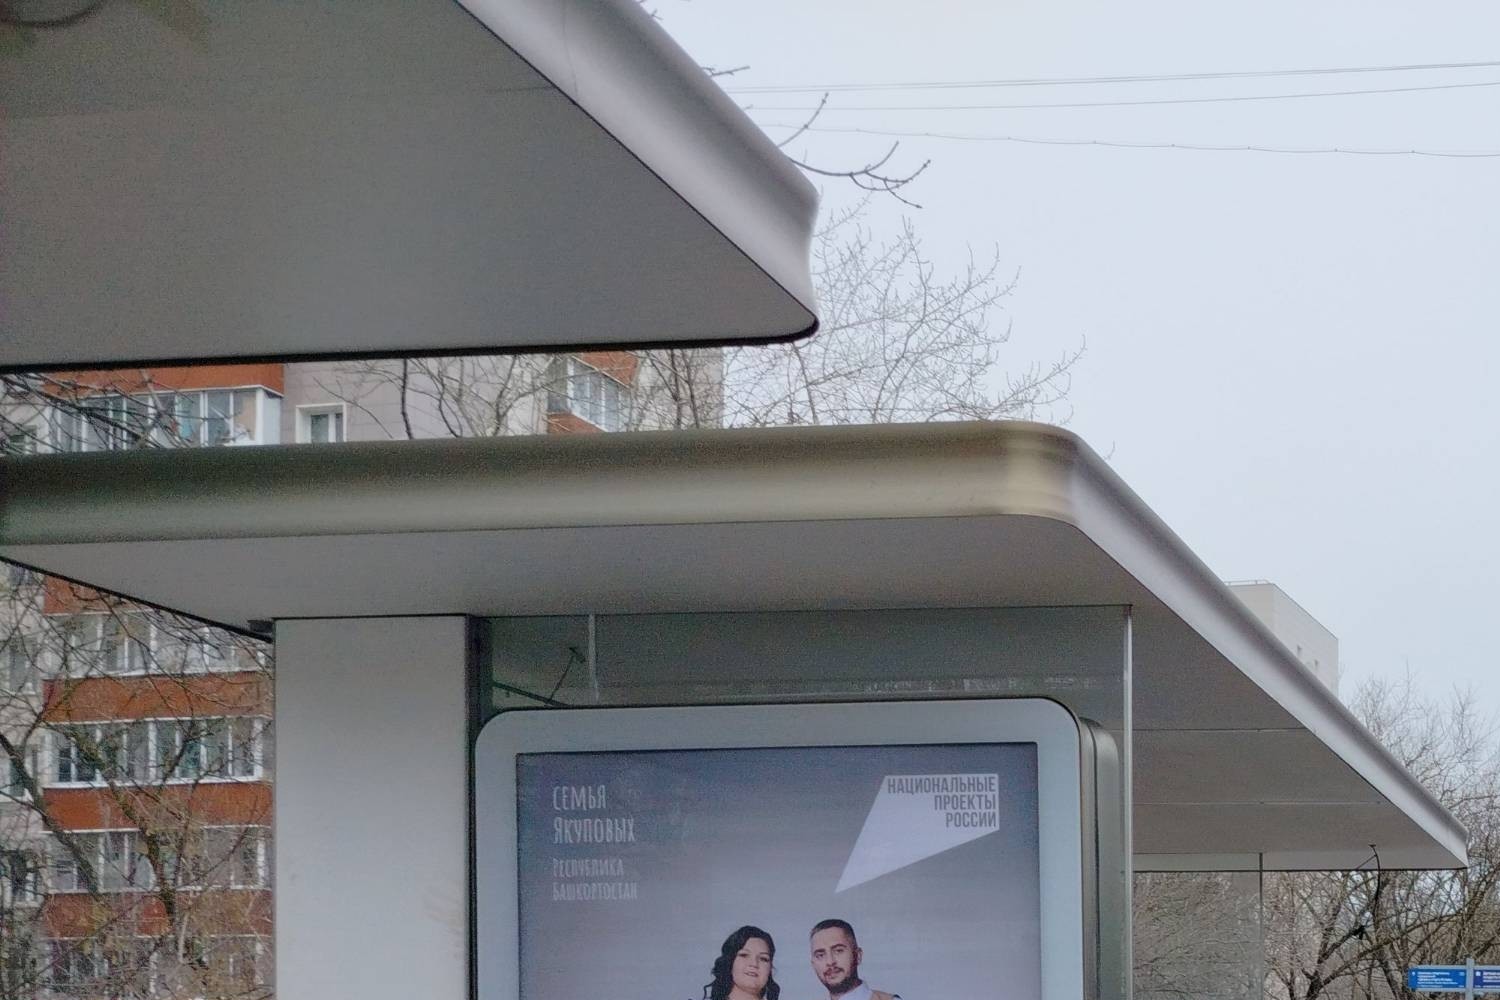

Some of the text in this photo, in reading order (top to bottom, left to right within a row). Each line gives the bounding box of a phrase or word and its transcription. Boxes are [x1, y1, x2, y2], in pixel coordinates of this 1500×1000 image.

[887, 776, 996, 795] НАЦИОНАЛЬНЫЕ
[553, 784, 607, 811] СЕМЬЯ
[934, 794, 996, 811] ПРОЕКТЫ
[945, 811, 996, 828] РОССИИ
[553, 815, 637, 844] ЯКУПОВЫХ
